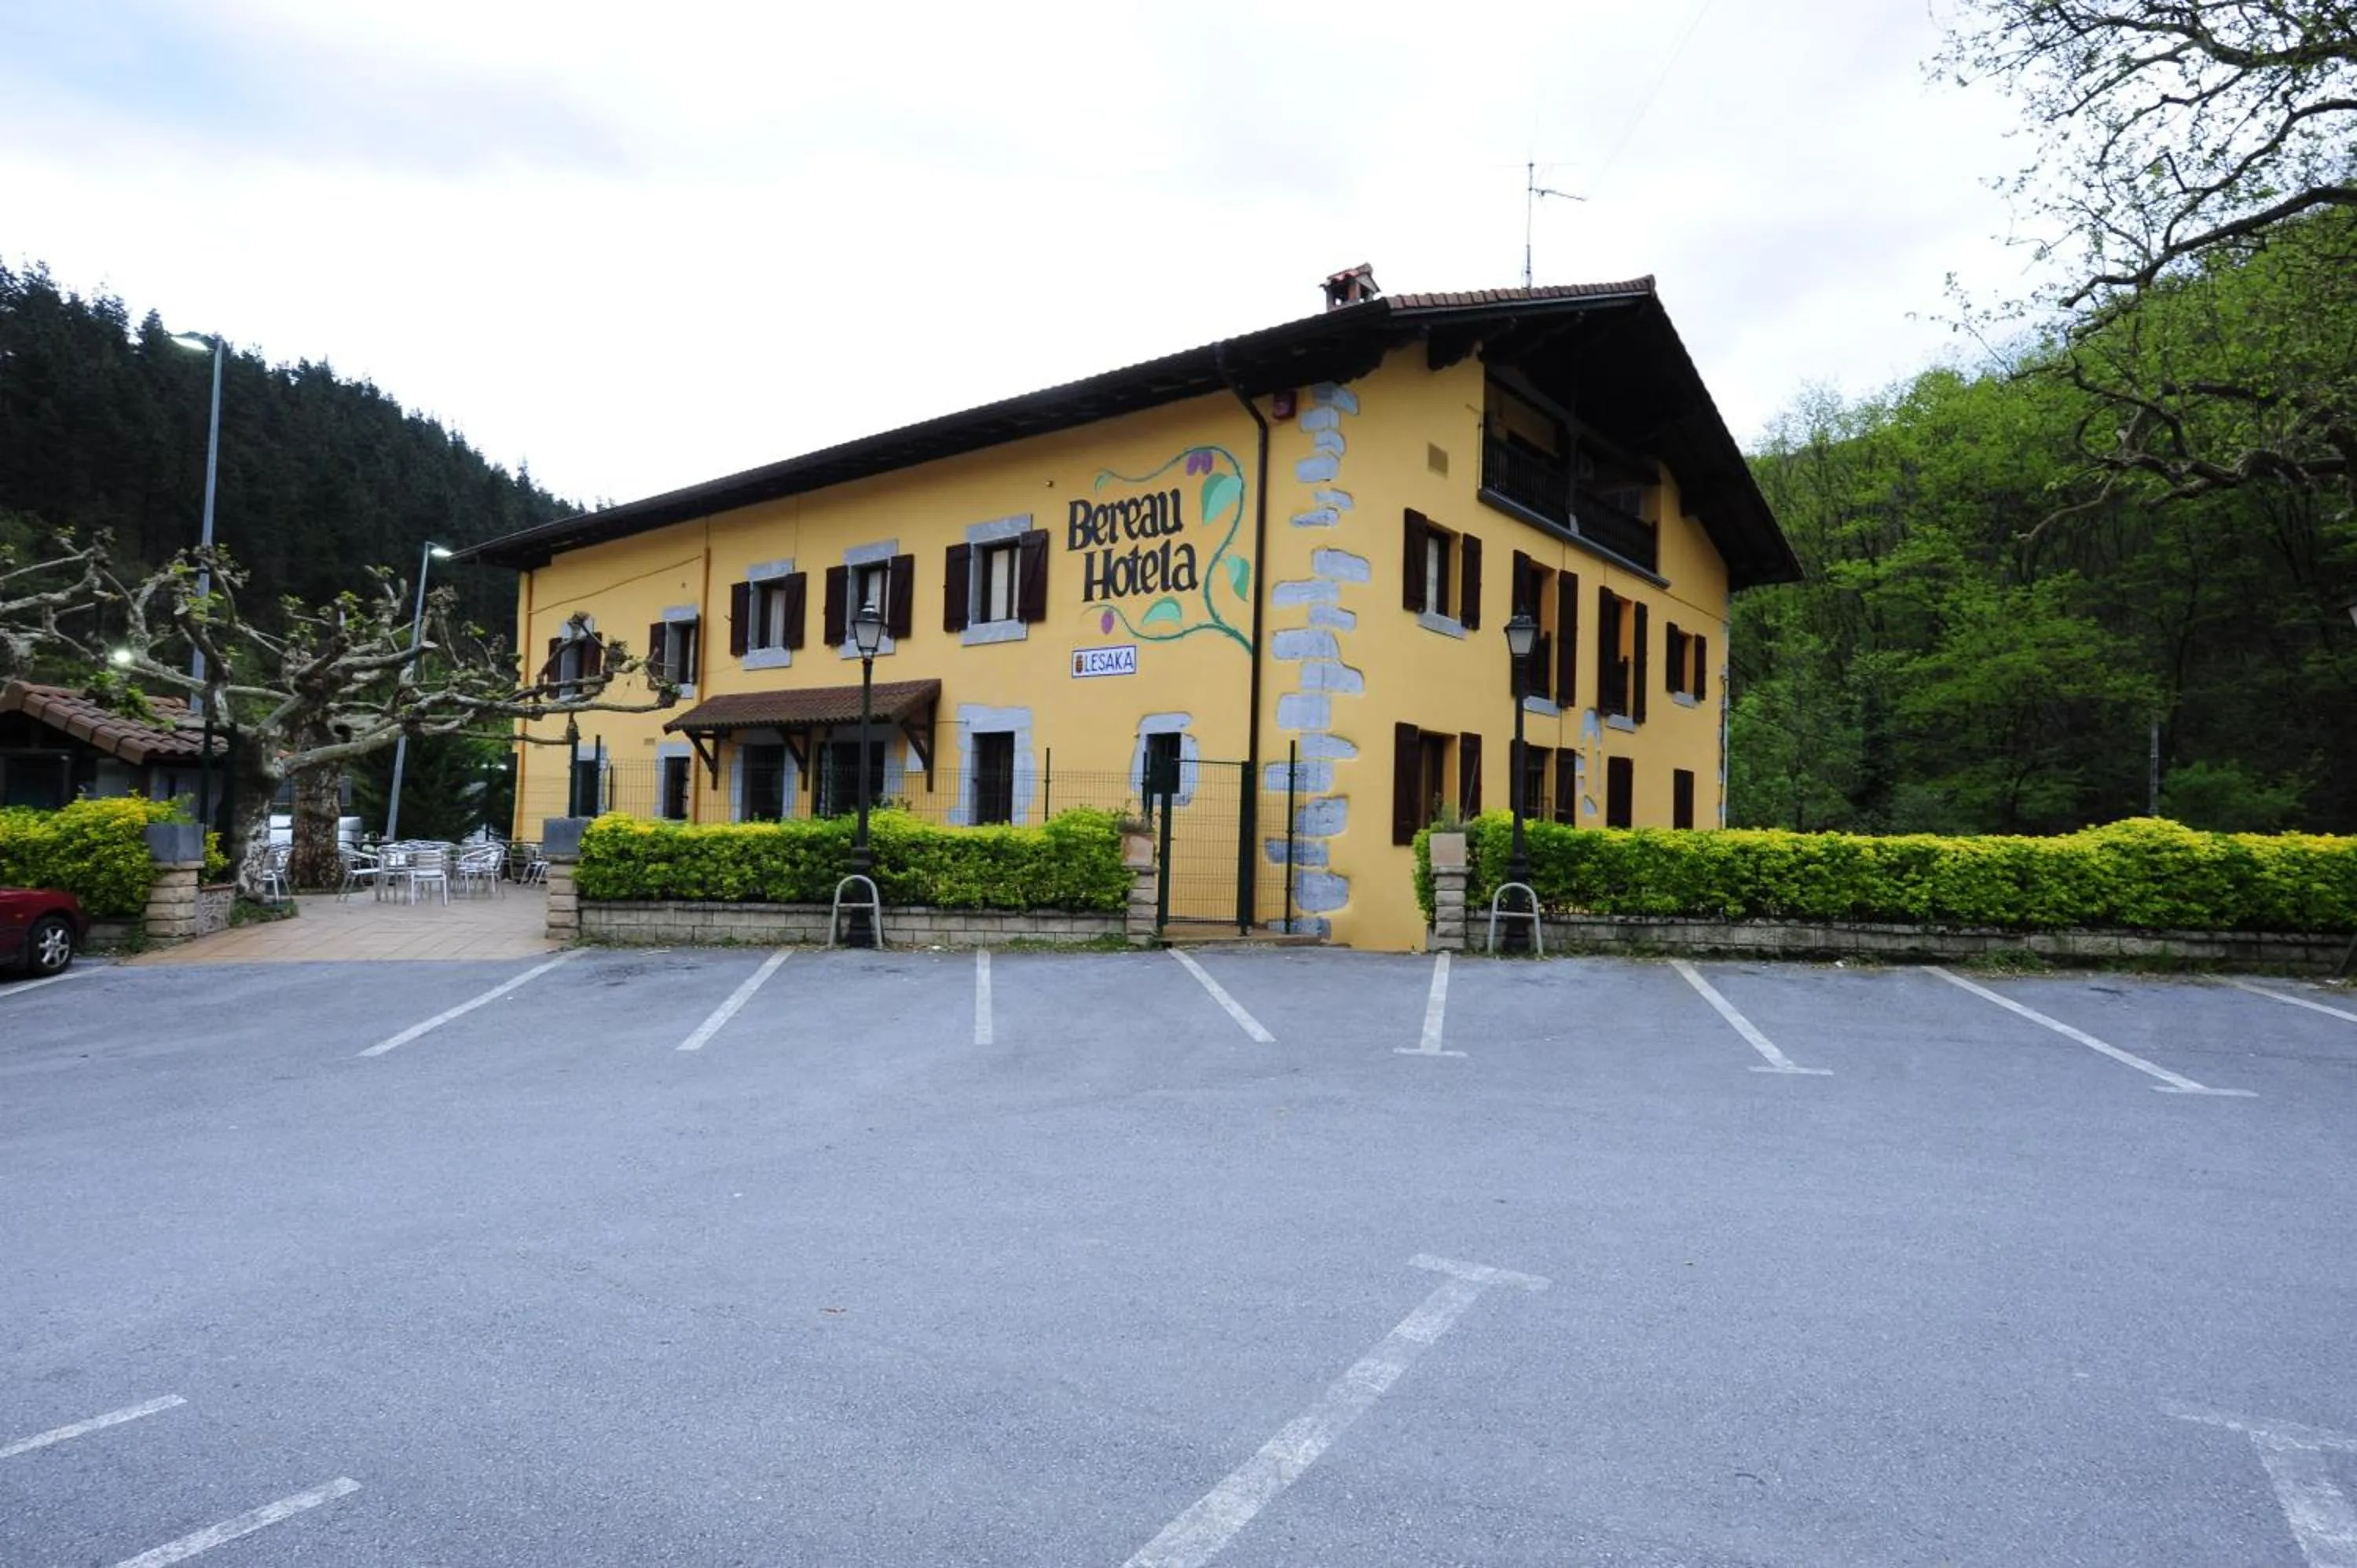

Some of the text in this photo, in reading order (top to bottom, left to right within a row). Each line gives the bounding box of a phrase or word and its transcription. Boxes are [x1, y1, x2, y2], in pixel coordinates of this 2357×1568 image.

[1067, 488, 1183, 551] Bereau
[1083, 539, 1198, 602] Hotela
[1084, 651, 1134, 672] LESAKA
